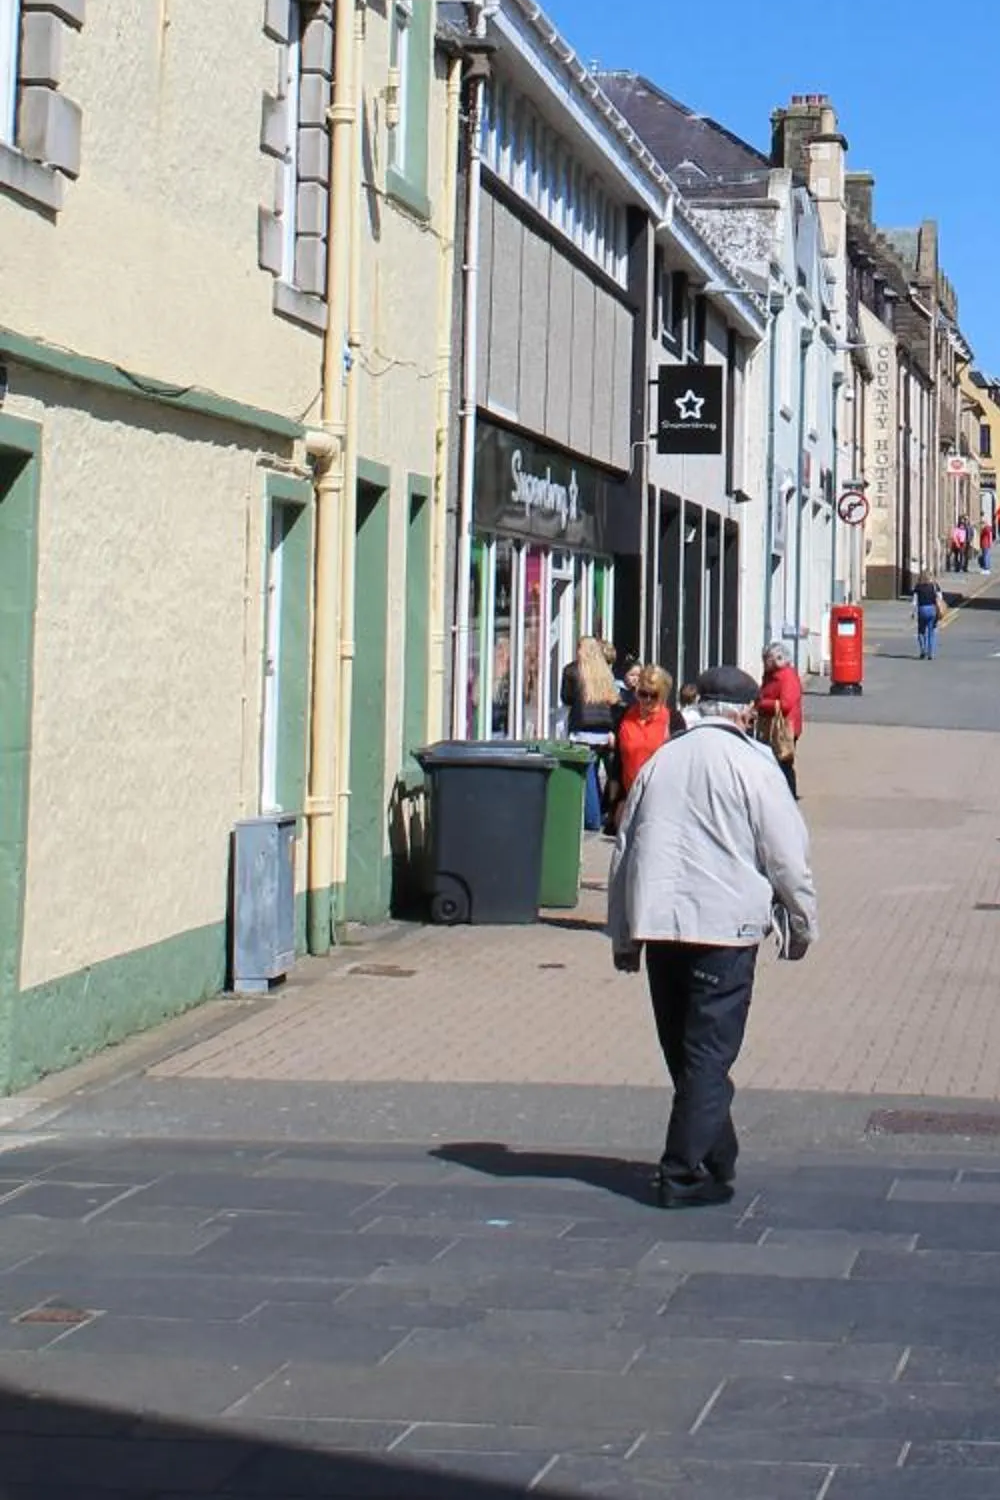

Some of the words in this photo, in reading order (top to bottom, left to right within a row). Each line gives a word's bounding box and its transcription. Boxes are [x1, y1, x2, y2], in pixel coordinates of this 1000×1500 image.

[876, 347, 889, 430] COUNTY
[511, 449, 568, 530] Superdry
[875, 439, 889, 509] HOTEL
